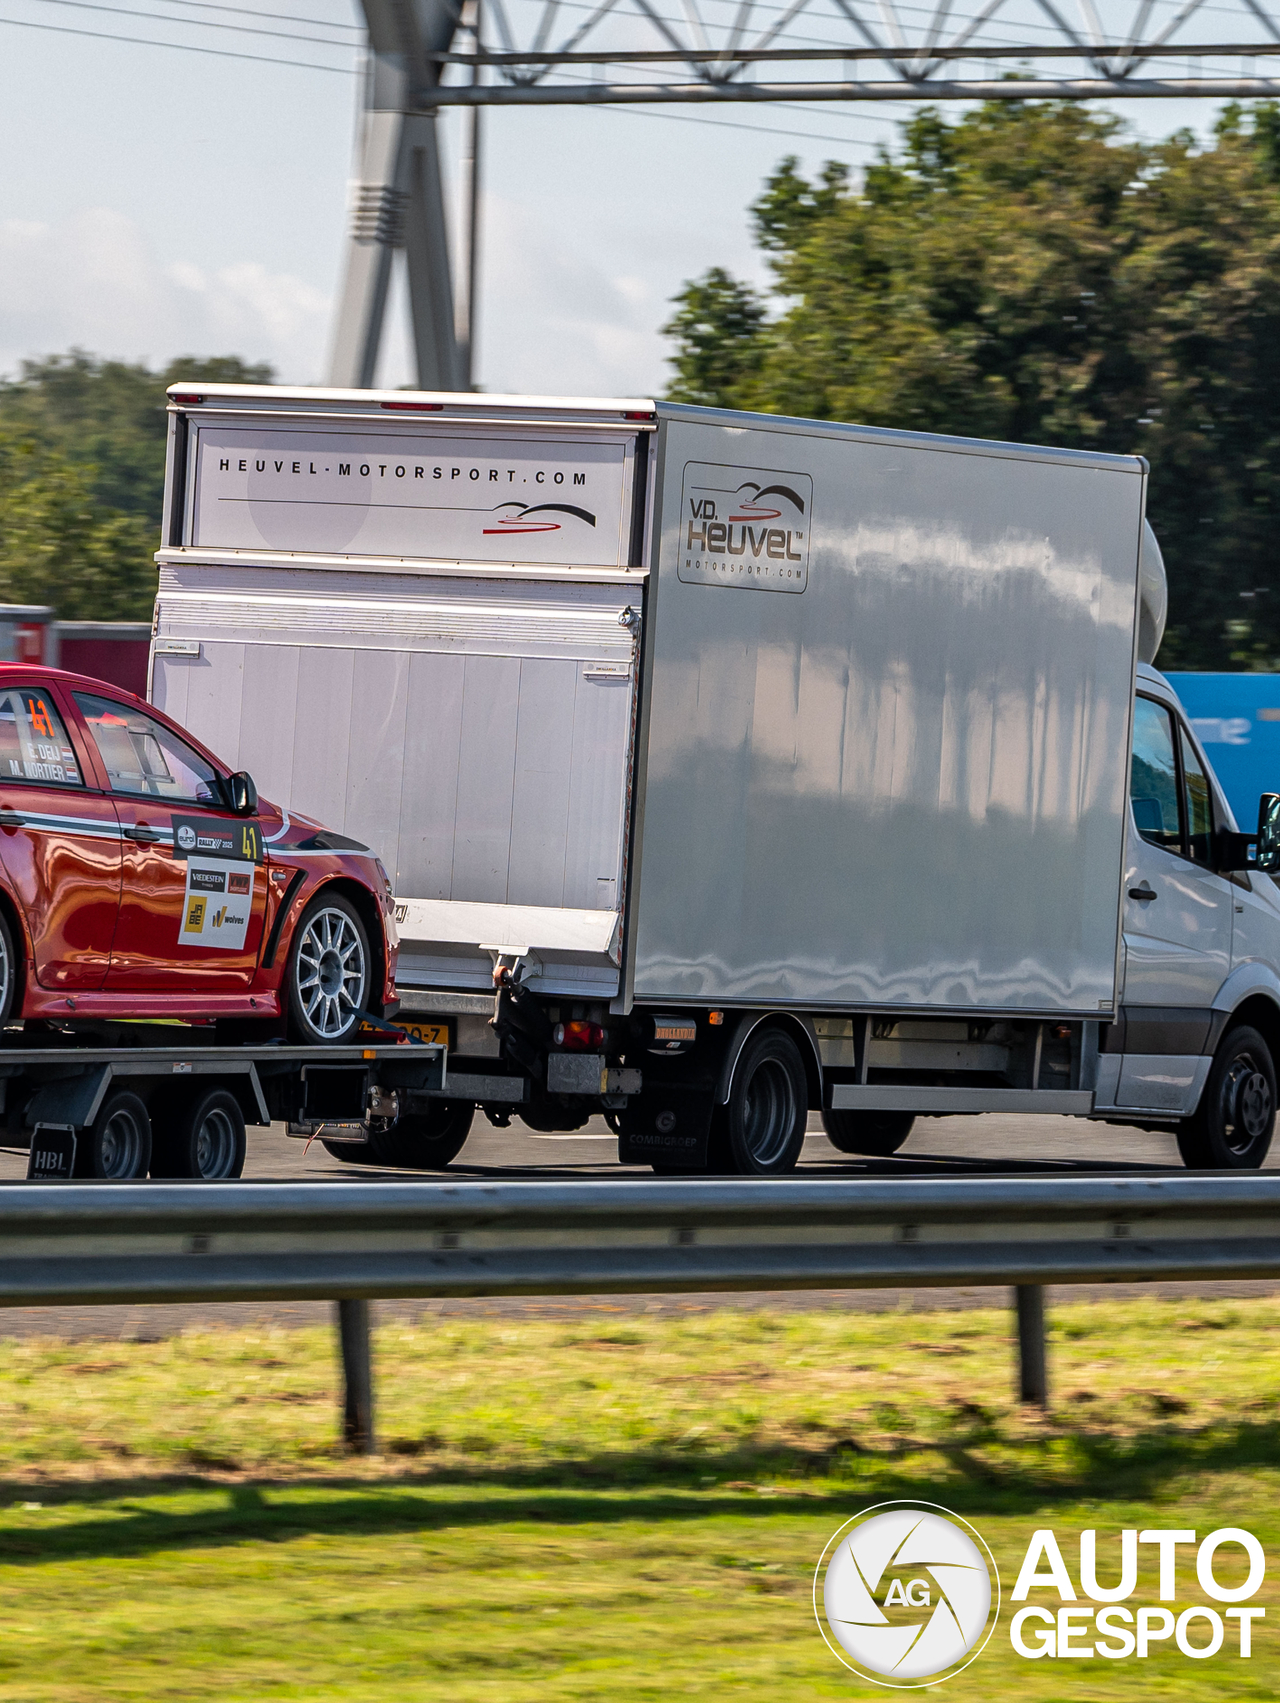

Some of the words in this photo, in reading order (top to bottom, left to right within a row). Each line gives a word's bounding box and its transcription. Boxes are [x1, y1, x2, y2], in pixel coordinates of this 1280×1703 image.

[220, 458, 587, 486] HEUVEL-MOTORSPORT.COM
[690, 498, 719, 521] V.D.
[686, 559, 802, 579] MOTORSPORT.COM
[28, 699, 55, 737] 41
[27, 742, 38, 759] E.
[37, 744, 61, 762] DEIJ
[9, 759, 24, 776] M.
[23, 761, 65, 781] MORTIER
[242, 827, 257, 859] 41
[225, 915, 244, 925] wolves
[35, 1150, 66, 1170] HBL
